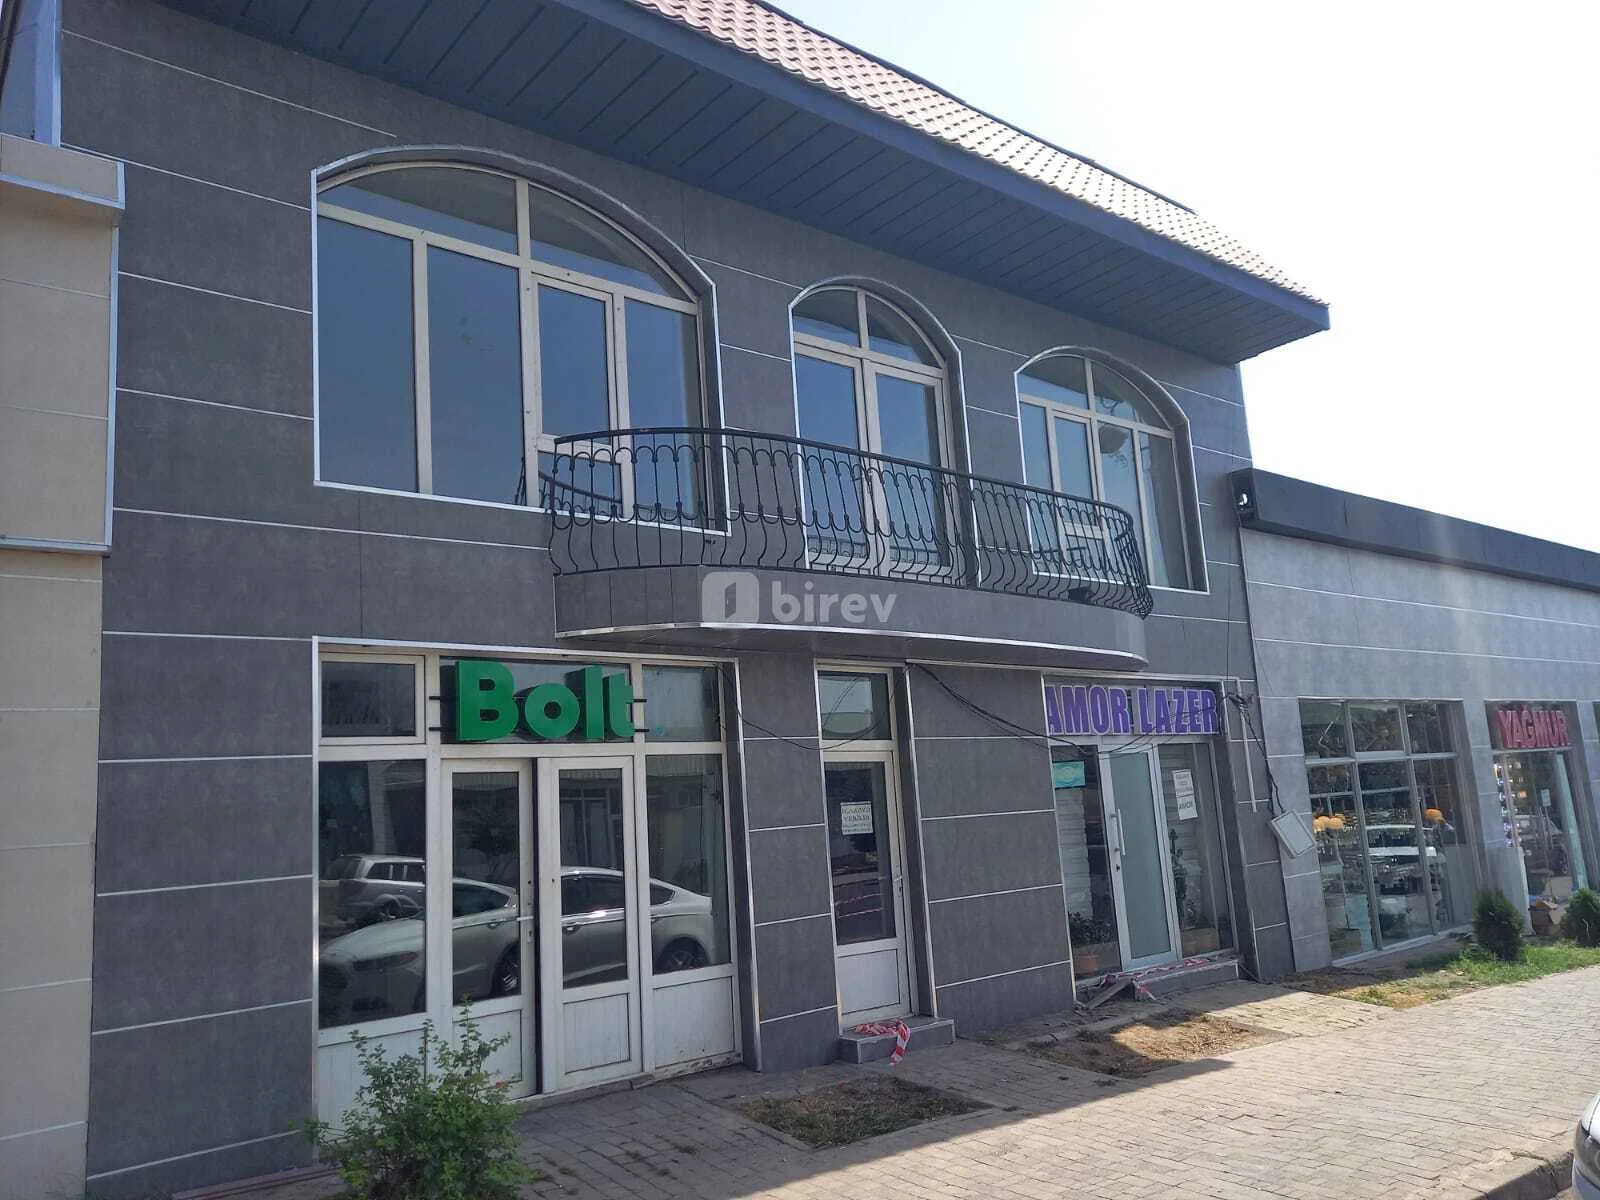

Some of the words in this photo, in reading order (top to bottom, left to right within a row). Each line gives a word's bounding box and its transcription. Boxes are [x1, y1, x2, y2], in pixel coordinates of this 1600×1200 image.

[457, 660, 636, 741] Bolt
[1044, 685, 1131, 735] AMOR
[1137, 687, 1219, 735] LAZER
